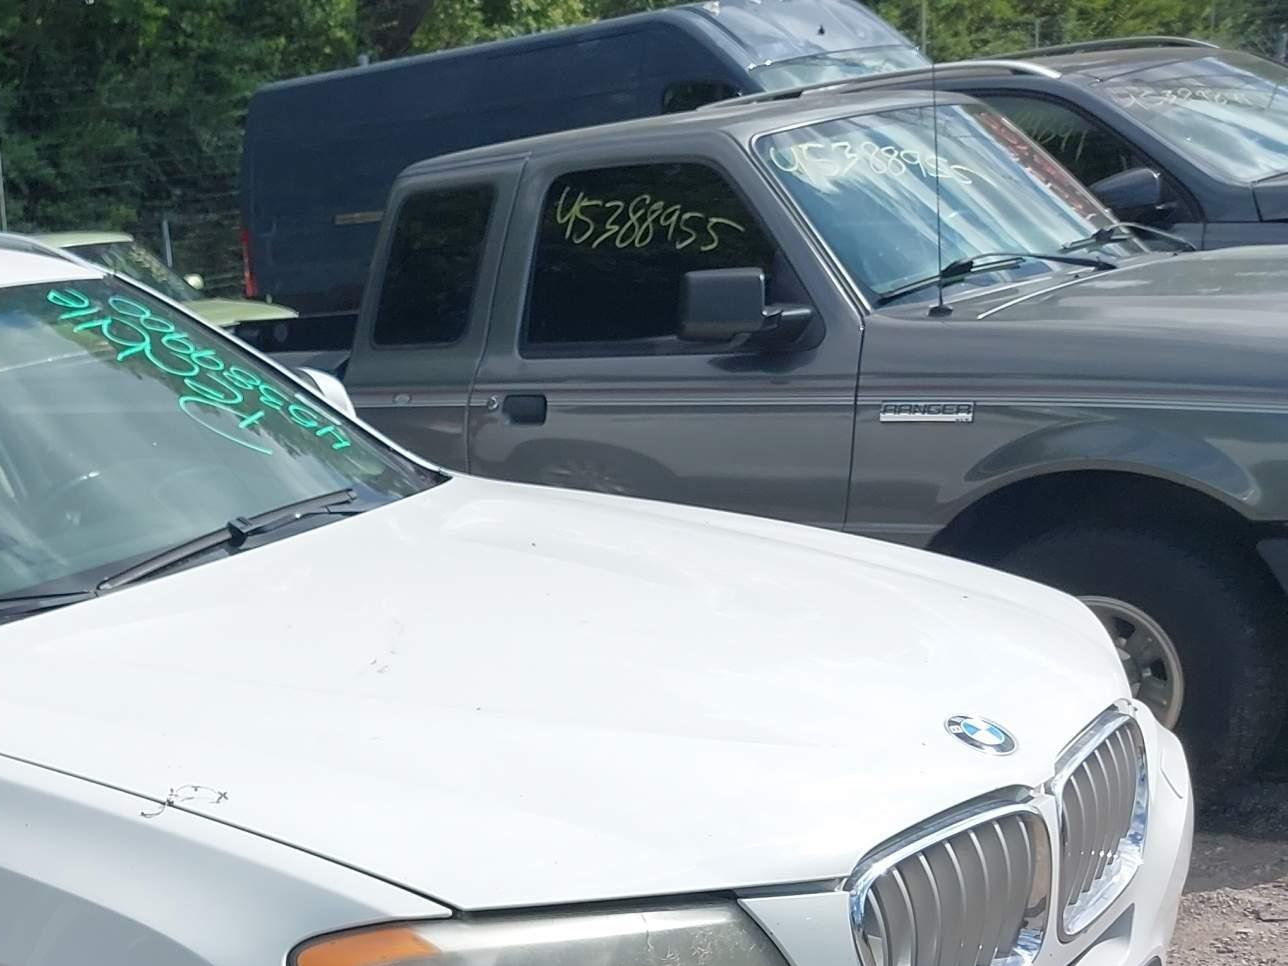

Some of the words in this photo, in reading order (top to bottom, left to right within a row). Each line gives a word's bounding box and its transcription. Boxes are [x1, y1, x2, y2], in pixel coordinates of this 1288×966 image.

[555, 185, 746, 251] 45388955
[108, 294, 353, 452] 45389900
[881, 402, 973, 416] RANGER
